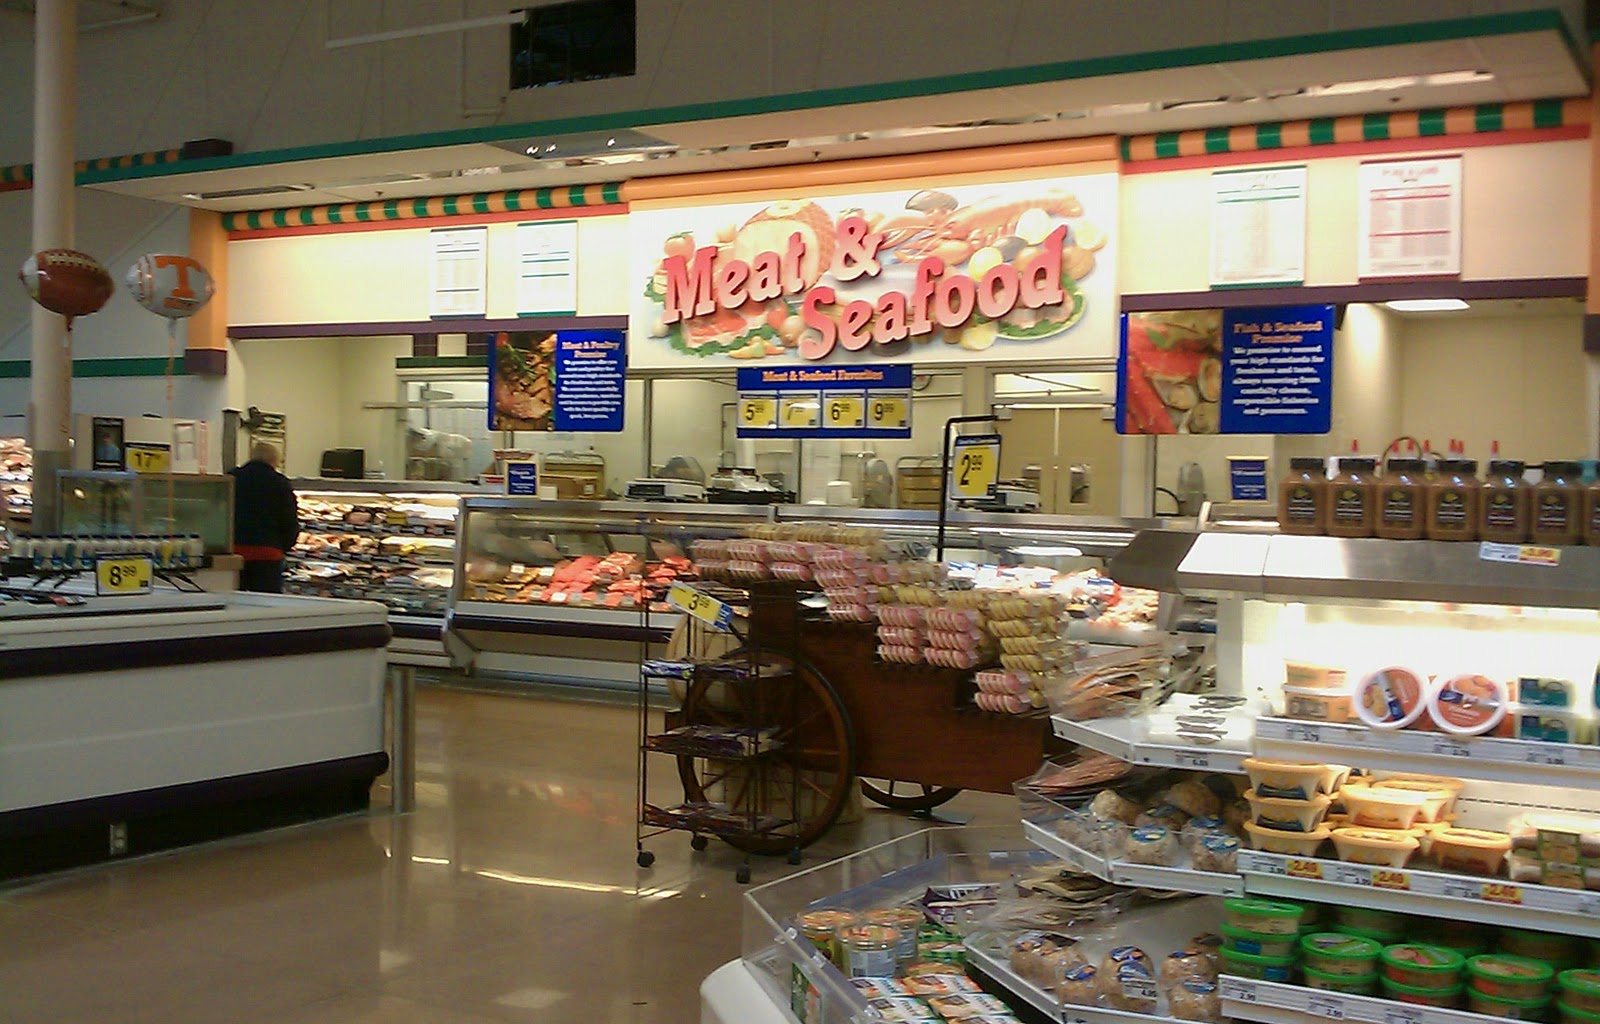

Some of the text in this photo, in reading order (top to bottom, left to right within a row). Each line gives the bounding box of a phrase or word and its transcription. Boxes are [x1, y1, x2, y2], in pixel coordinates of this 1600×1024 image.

[661, 231, 807, 325] Meat
[836, 216, 887, 283] &
[799, 223, 1069, 361] Seafood
